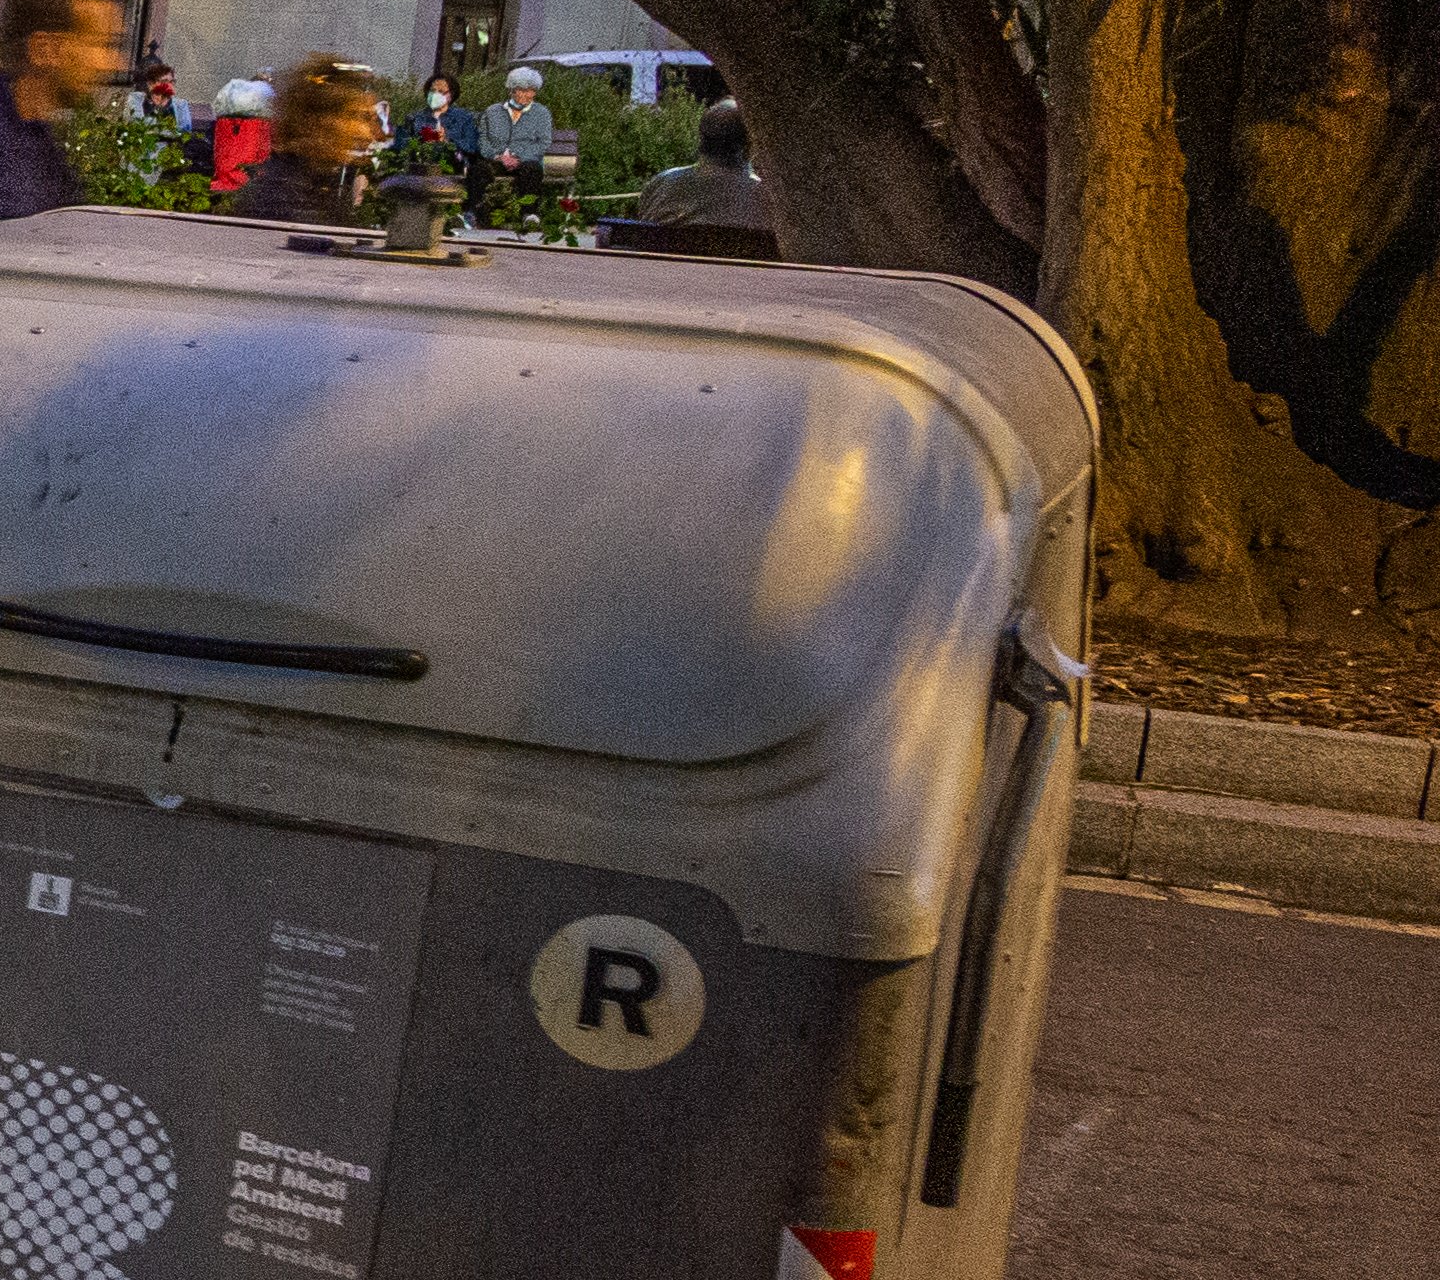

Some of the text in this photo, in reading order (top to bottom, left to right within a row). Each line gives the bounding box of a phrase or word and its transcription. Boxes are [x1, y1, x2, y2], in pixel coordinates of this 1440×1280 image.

[573, 944, 667, 1038] R
[238, 1130, 372, 1183] Barcelona
[229, 1180, 344, 1227] Ambient
[232, 1160, 347, 1202] pel Medi
[226, 1204, 311, 1243] Gestió
[221, 1230, 359, 1280] de residus
